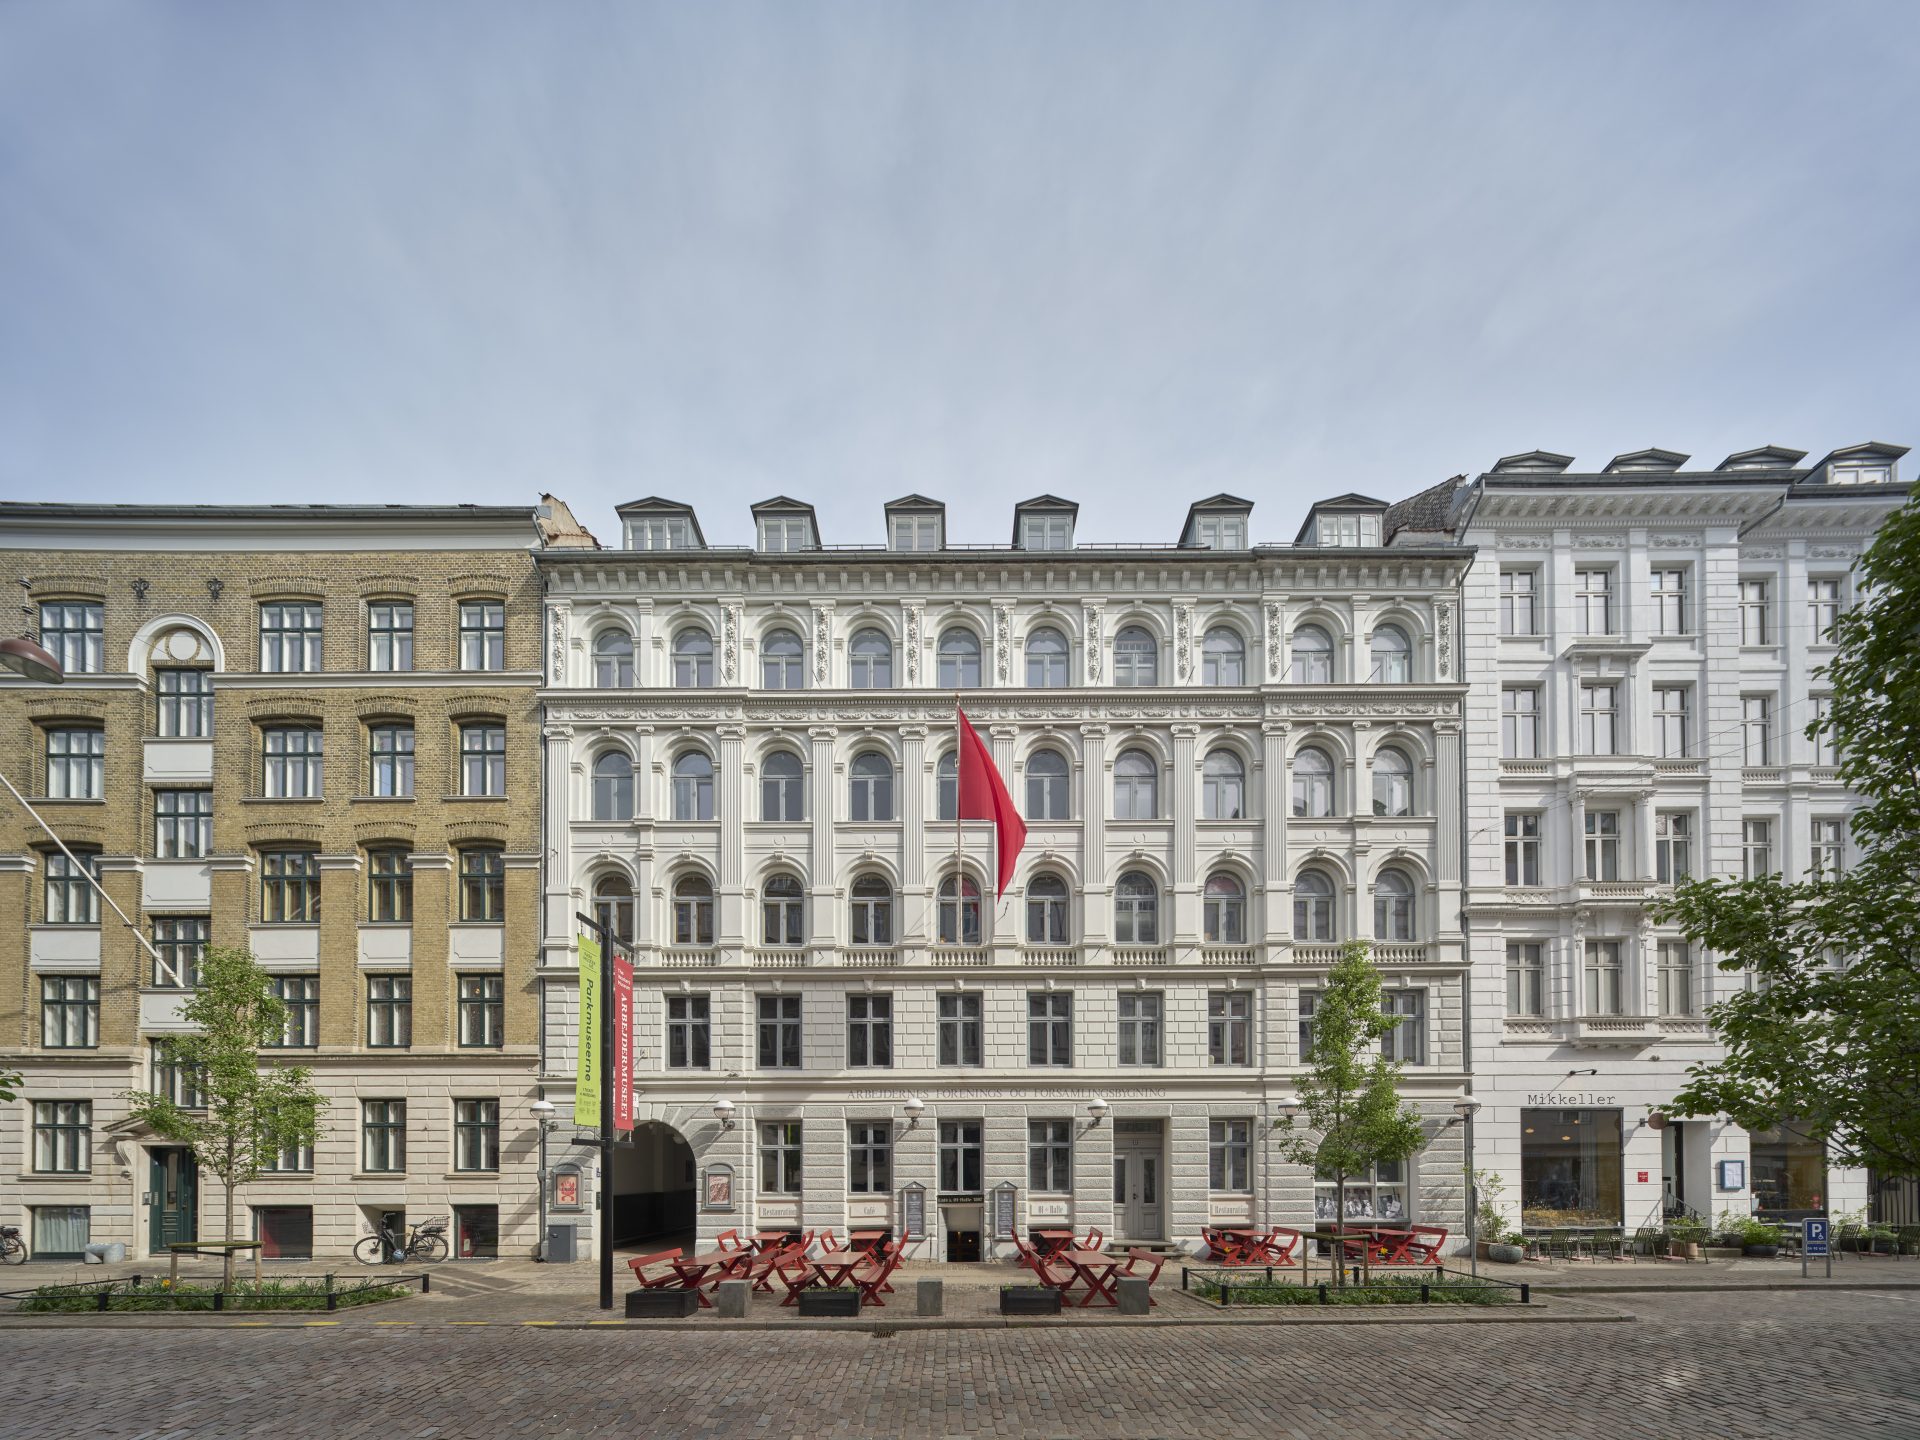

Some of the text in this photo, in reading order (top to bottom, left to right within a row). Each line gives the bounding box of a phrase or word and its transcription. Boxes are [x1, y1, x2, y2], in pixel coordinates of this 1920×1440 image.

[585, 978, 594, 1081] Parkmuseerne
[848, 1088, 1166, 1099] ARBEJDERNES FORENINGS OG FORSAMLINGSBYGNING
[1528, 1093, 1616, 1105] Mikkeller
[1811, 1223, 1822, 1238] P
